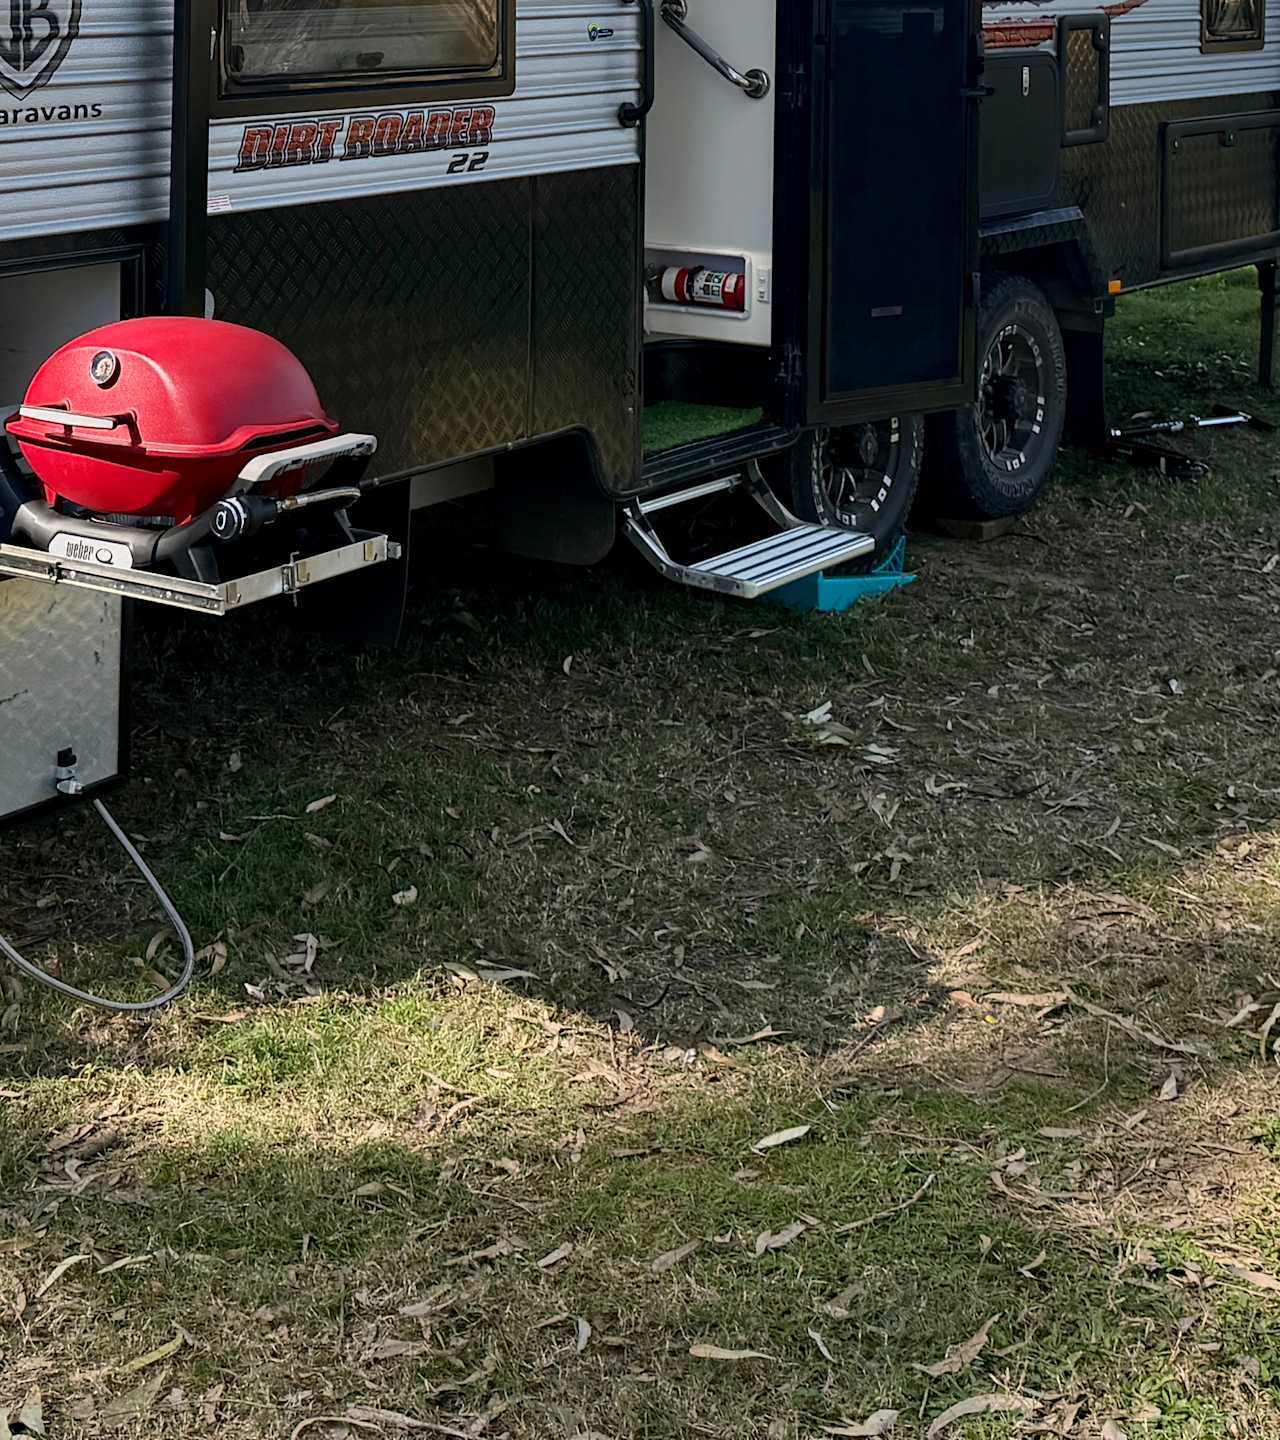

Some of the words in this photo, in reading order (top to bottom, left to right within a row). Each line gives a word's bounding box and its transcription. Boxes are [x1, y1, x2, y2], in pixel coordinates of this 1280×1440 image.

[233, 117, 343, 173] DIRT
[340, 105, 496, 161] ROADER
[446, 151, 489, 174] 22
[66, 540, 94, 560] weber
